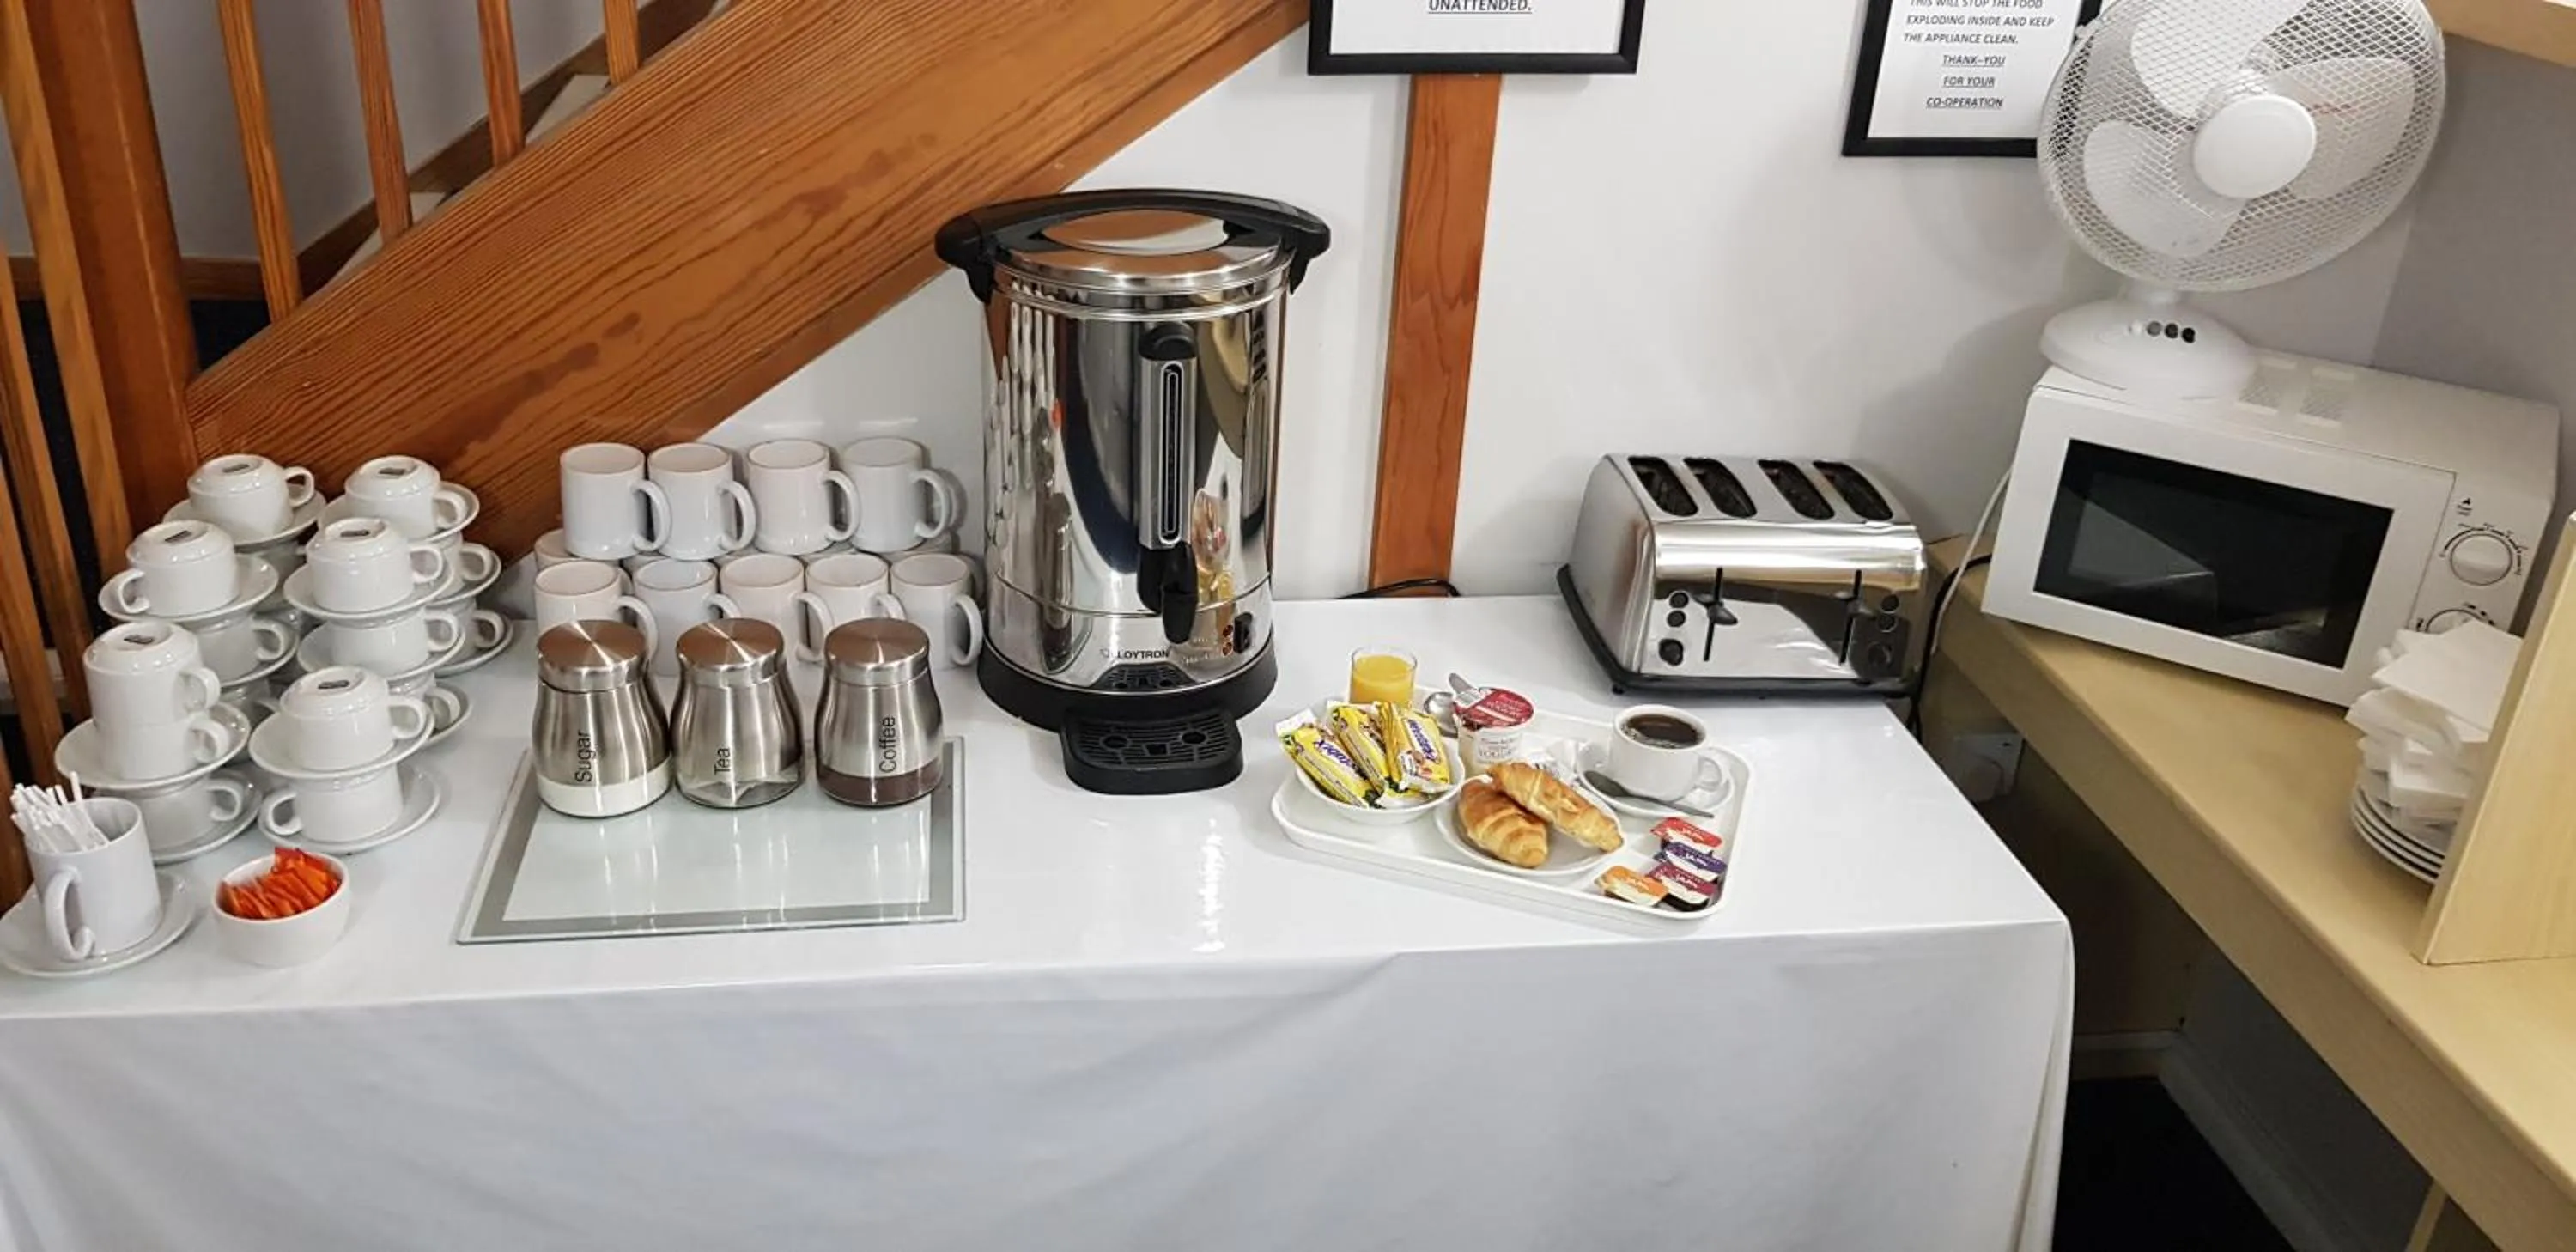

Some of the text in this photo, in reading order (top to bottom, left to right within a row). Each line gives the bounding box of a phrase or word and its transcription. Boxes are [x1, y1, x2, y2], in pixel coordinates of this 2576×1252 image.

[1428, 0, 1533, 12] UNATTENDED.
[1907, 15, 2055, 27] EXPLODING INSIDE AND KEEP
[1904, 33, 2019, 44] THE APPLIANCE CLEAN.
[1942, 76, 1996, 87] FOR YOUR
[1926, 97, 2003, 108] CO-OPERATION
[879, 717, 897, 773] Coffee
[574, 729, 596, 782] Sugar
[714, 748, 731, 775] Tea
